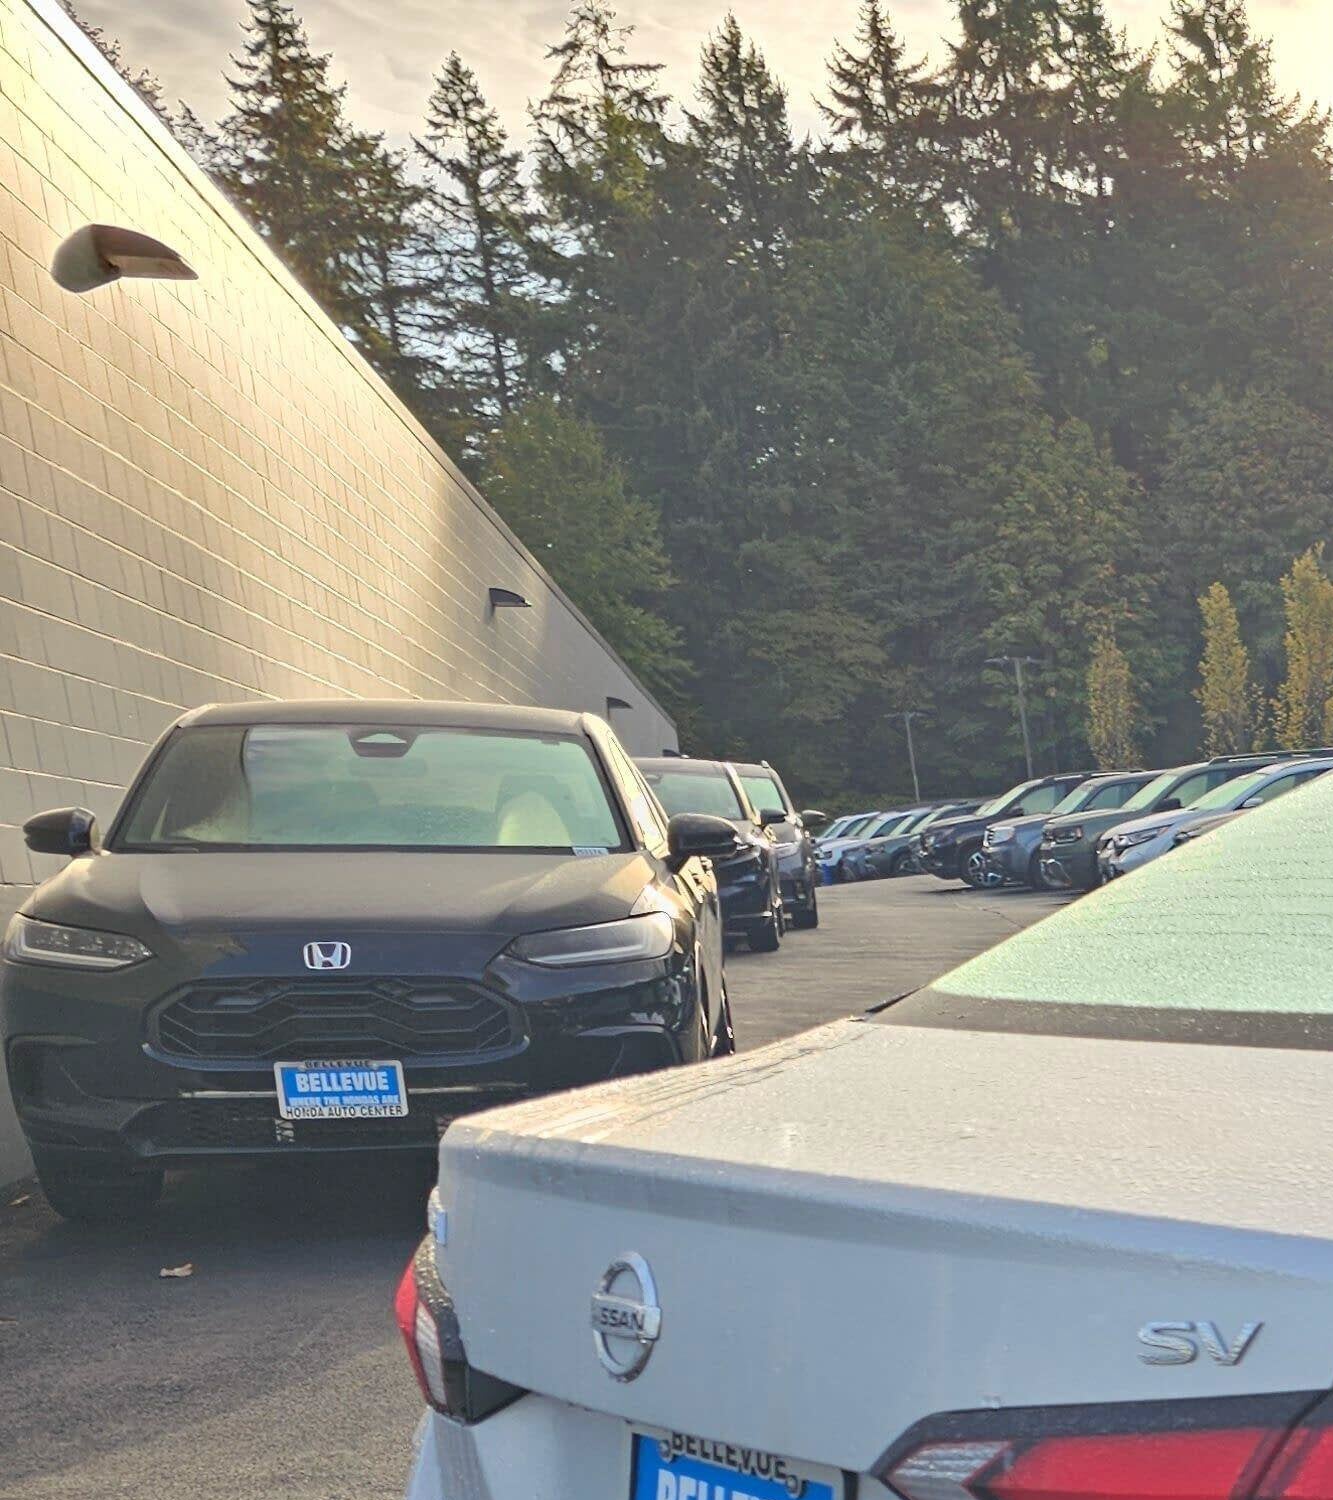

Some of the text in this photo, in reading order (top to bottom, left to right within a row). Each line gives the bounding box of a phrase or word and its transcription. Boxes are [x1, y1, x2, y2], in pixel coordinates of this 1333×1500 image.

[295, 1071, 389, 1093] BELLEVUE
[286, 1105, 403, 1118] HONDA AUTO CENTER
[1137, 1321, 1264, 1366] SV
[671, 1432, 788, 1480] BELLEVUE
